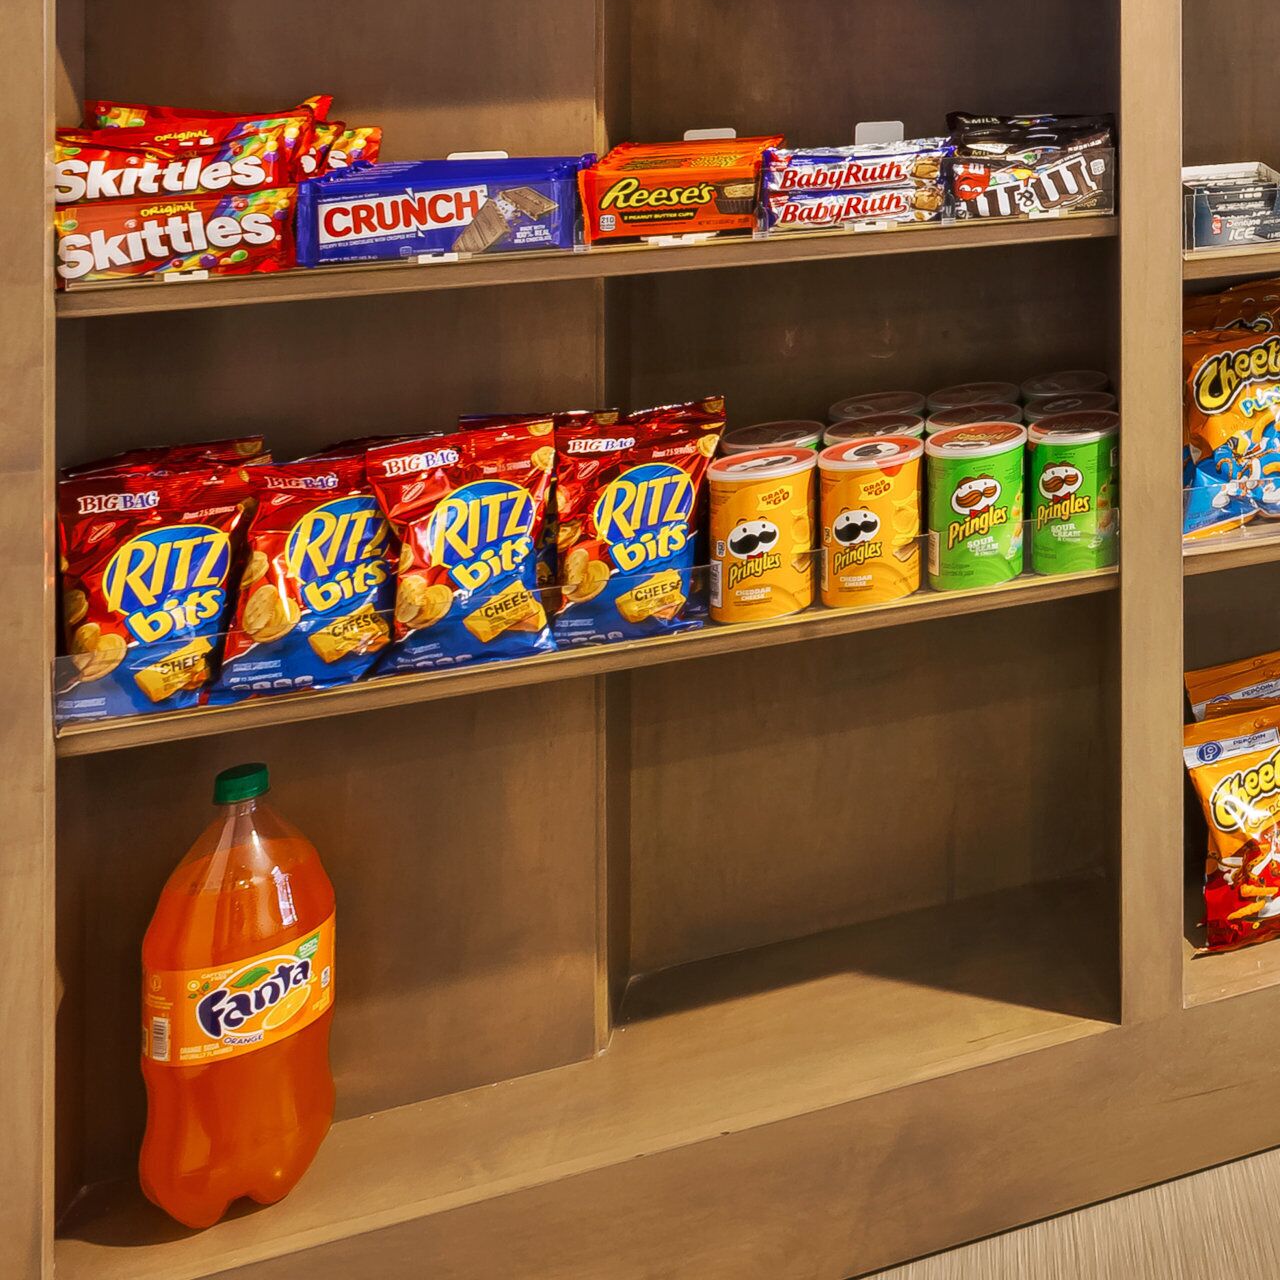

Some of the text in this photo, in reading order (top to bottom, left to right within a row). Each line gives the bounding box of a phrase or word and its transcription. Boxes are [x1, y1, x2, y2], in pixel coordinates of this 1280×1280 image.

[55, 155, 266, 203] Skittles
[324, 190, 479, 238] CRUNCH
[57, 212, 276, 279] Skittles
[267, 474, 338, 489] BIG BAG
[385, 449, 458, 476] BIG BAG
[79, 492, 159, 514] BIG BAG
[596, 474, 691, 540] RITZ
[863, 480, 885, 492] GRAB
[432, 488, 530, 567] RITZ
[948, 506, 1007, 550] Pringles
[1037, 494, 1090, 530] Pringles
[1051, 524, 1075, 534] SOUR
[287, 510, 390, 583] RITZ
[453, 536, 530, 590] bits
[614, 524, 688, 571] bits
[834, 541, 882, 575] Pringles
[967, 537, 993, 548] SOUR
[108, 531, 228, 614] RITZ
[304, 560, 387, 612] bits
[635, 581, 682, 602] CHEESE
[728, 552, 781, 589] Pringles
[128, 589, 224, 644] bits
[198, 960, 310, 1037] Fanta
[224, 1034, 263, 1044] ORANGE
